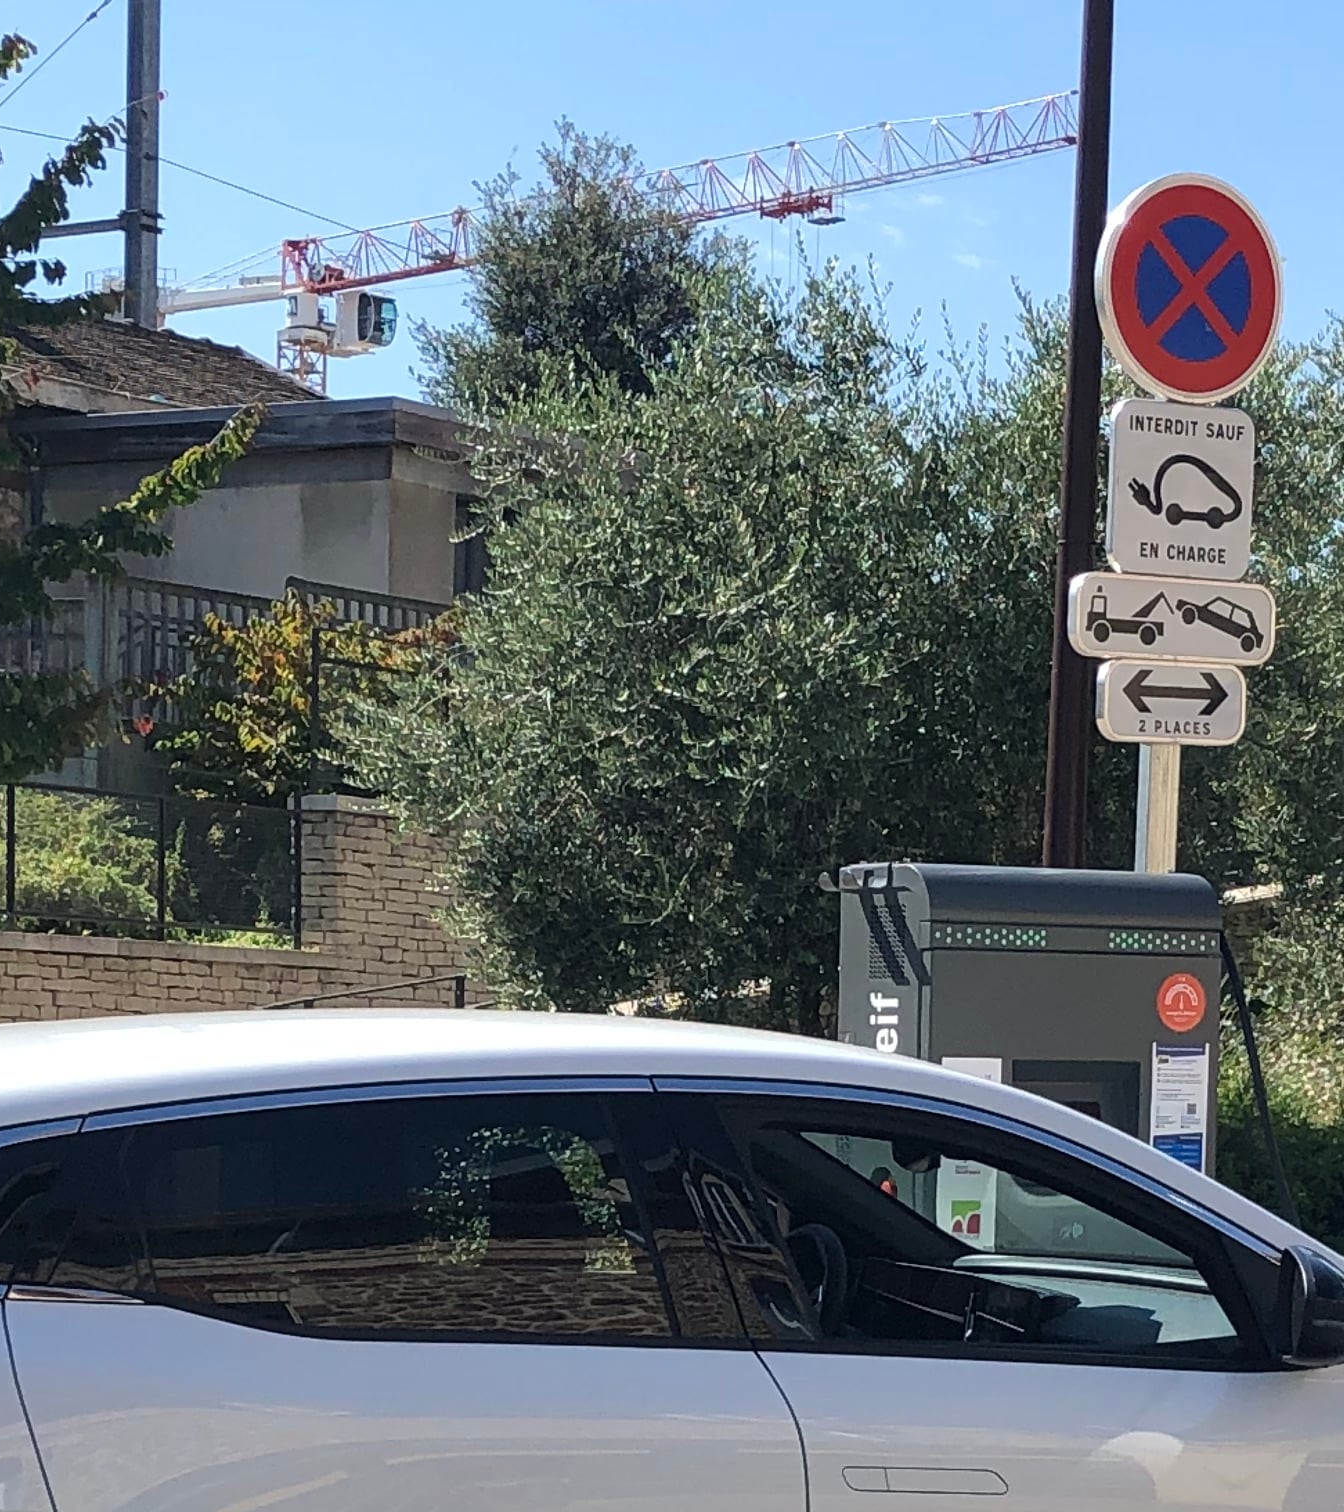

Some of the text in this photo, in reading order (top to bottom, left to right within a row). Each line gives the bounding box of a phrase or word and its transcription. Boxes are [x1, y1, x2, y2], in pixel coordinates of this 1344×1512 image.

[1129, 414, 1245, 441] INTERDIT SAUF
[1140, 541, 1226, 565] EN CHARGE
[1139, 720, 1210, 735] 2 PLACES
